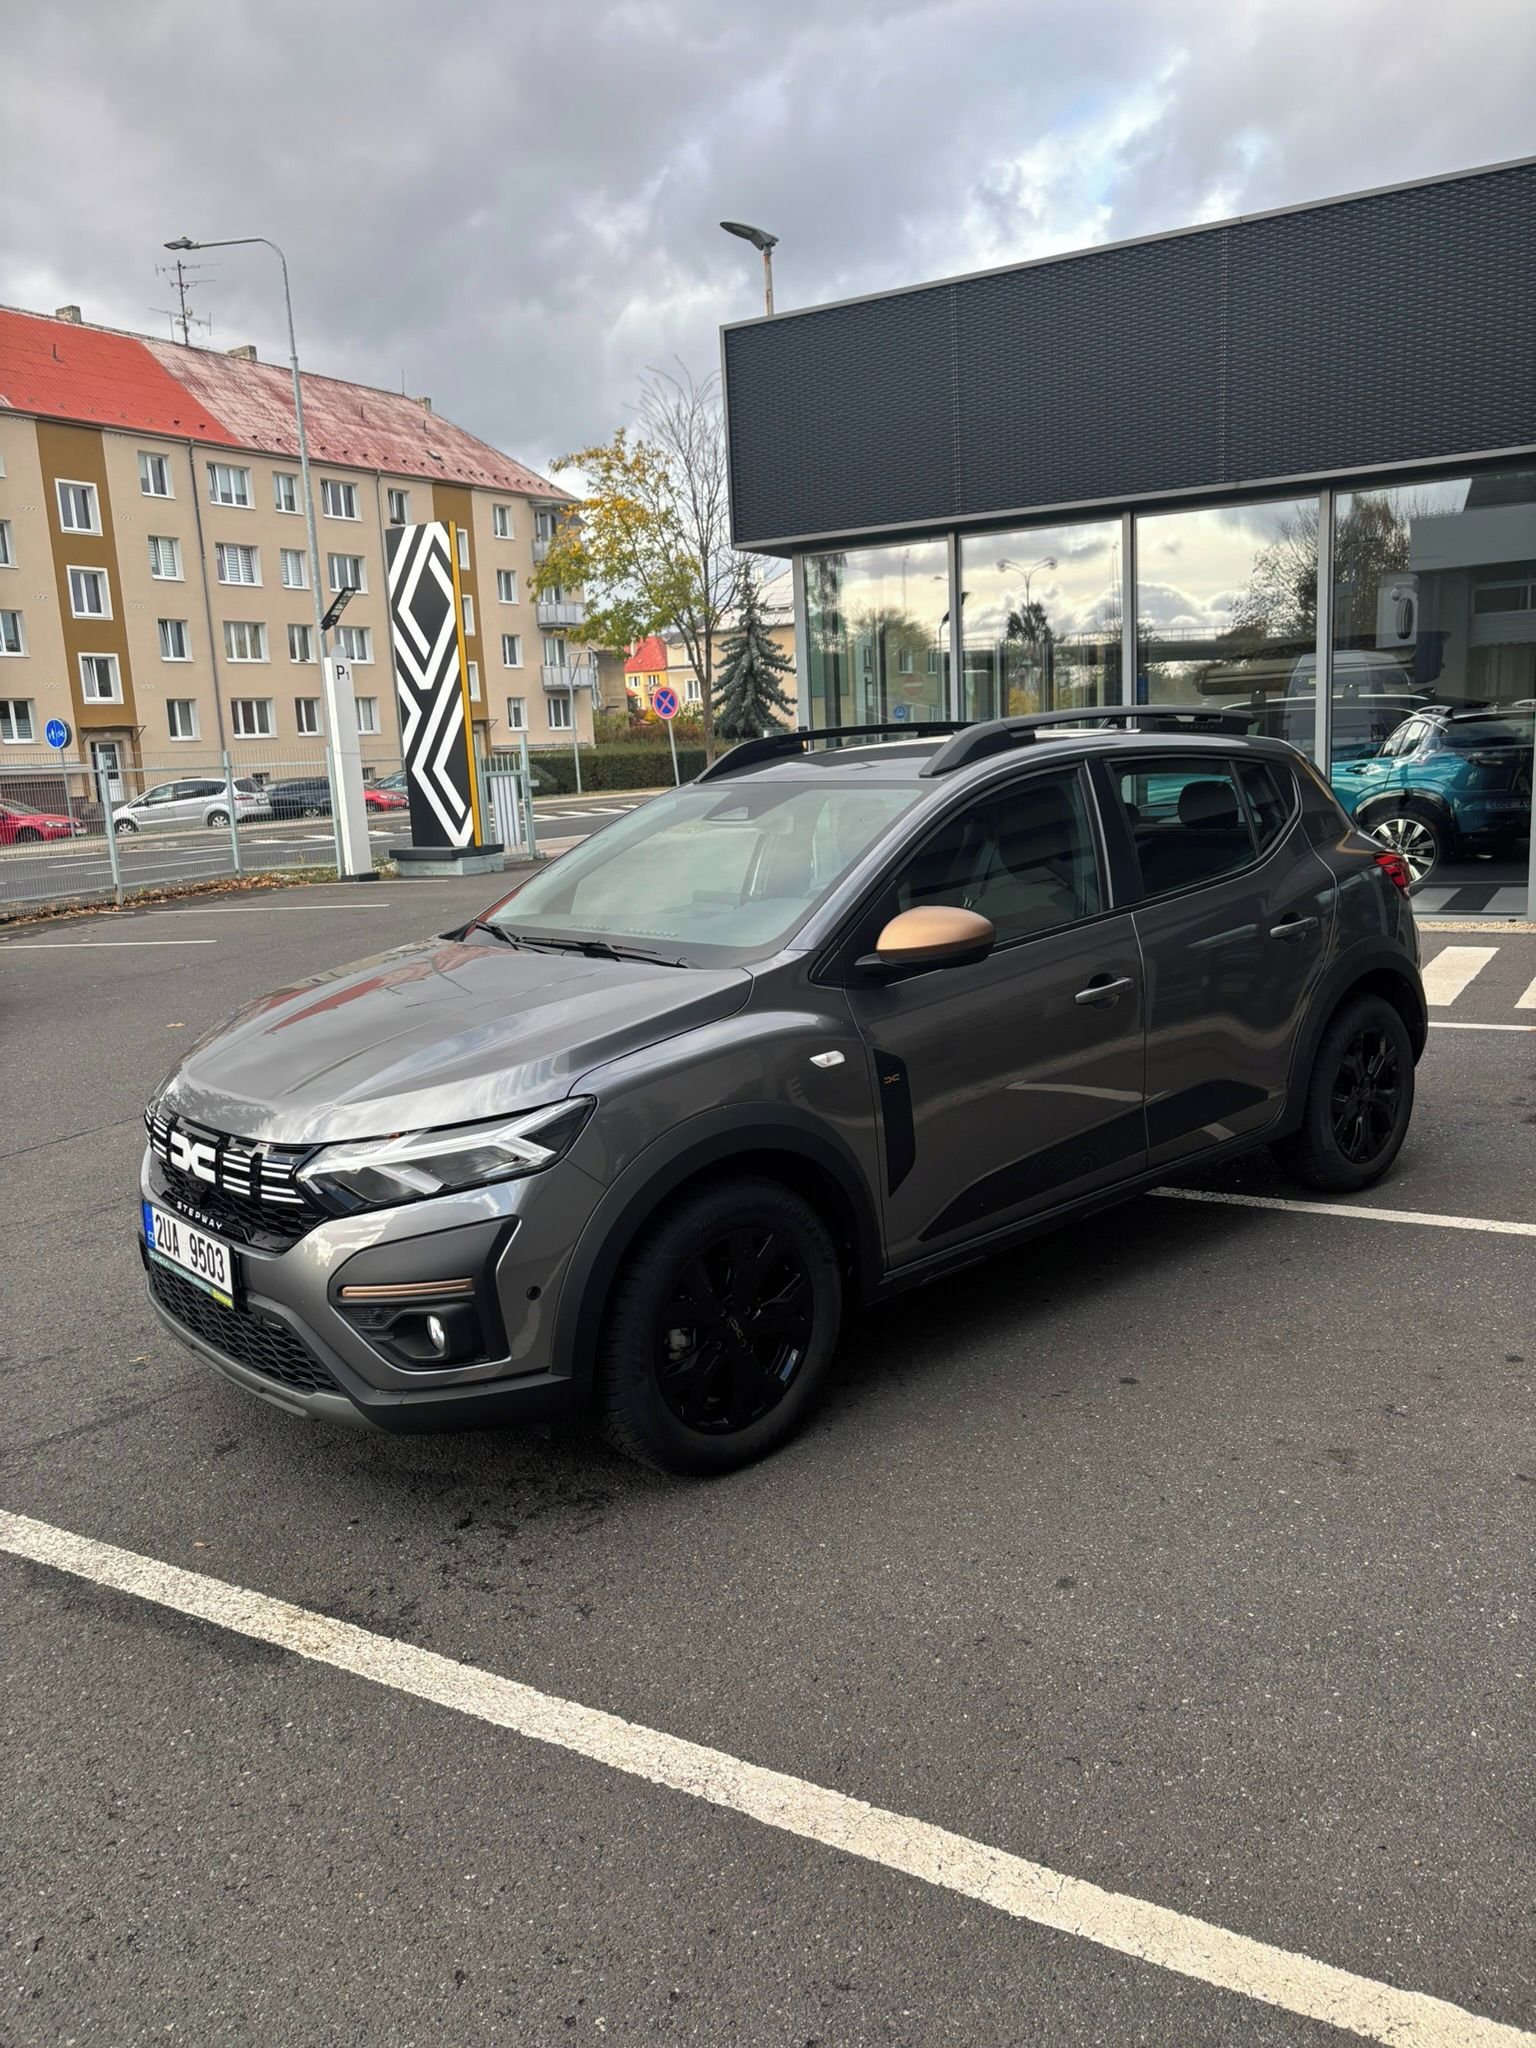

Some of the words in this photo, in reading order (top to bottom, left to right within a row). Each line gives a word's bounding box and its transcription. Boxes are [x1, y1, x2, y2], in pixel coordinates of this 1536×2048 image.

[176, 1201, 222, 1230] STEPWAY
[155, 1214, 181, 1258] 2UA
[189, 1232, 225, 1284] 9503
